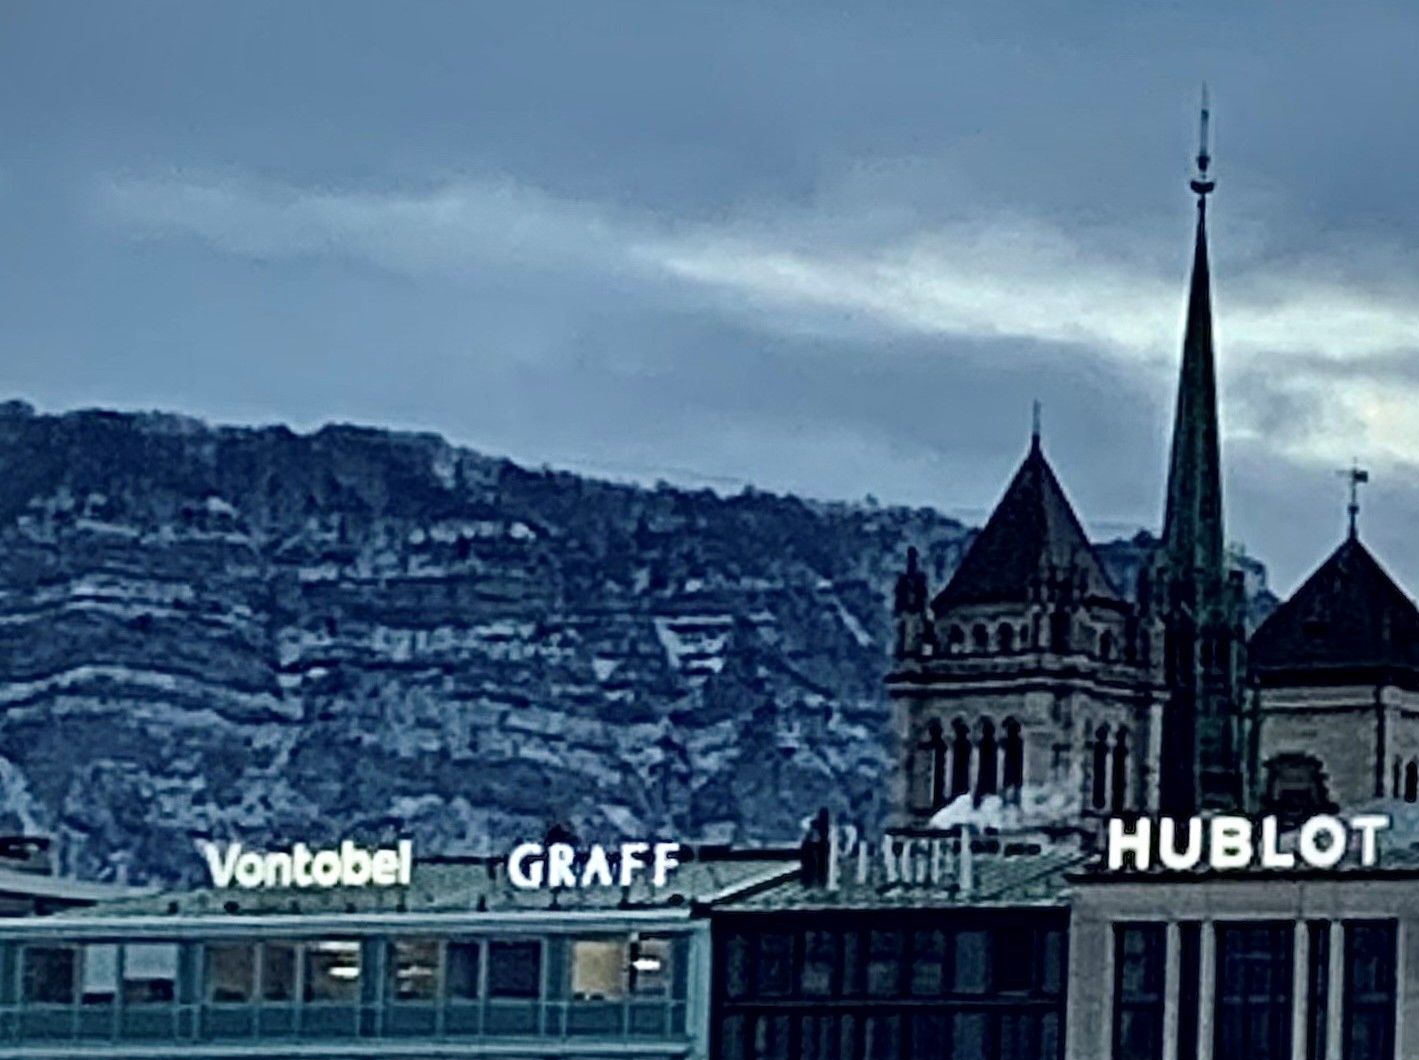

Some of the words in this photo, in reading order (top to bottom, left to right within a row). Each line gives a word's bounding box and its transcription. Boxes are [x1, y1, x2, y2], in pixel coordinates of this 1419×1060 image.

[202, 839, 413, 888] Vontobel
[507, 842, 680, 889] GRAFF
[1107, 813, 1392, 872] HUBLOT
